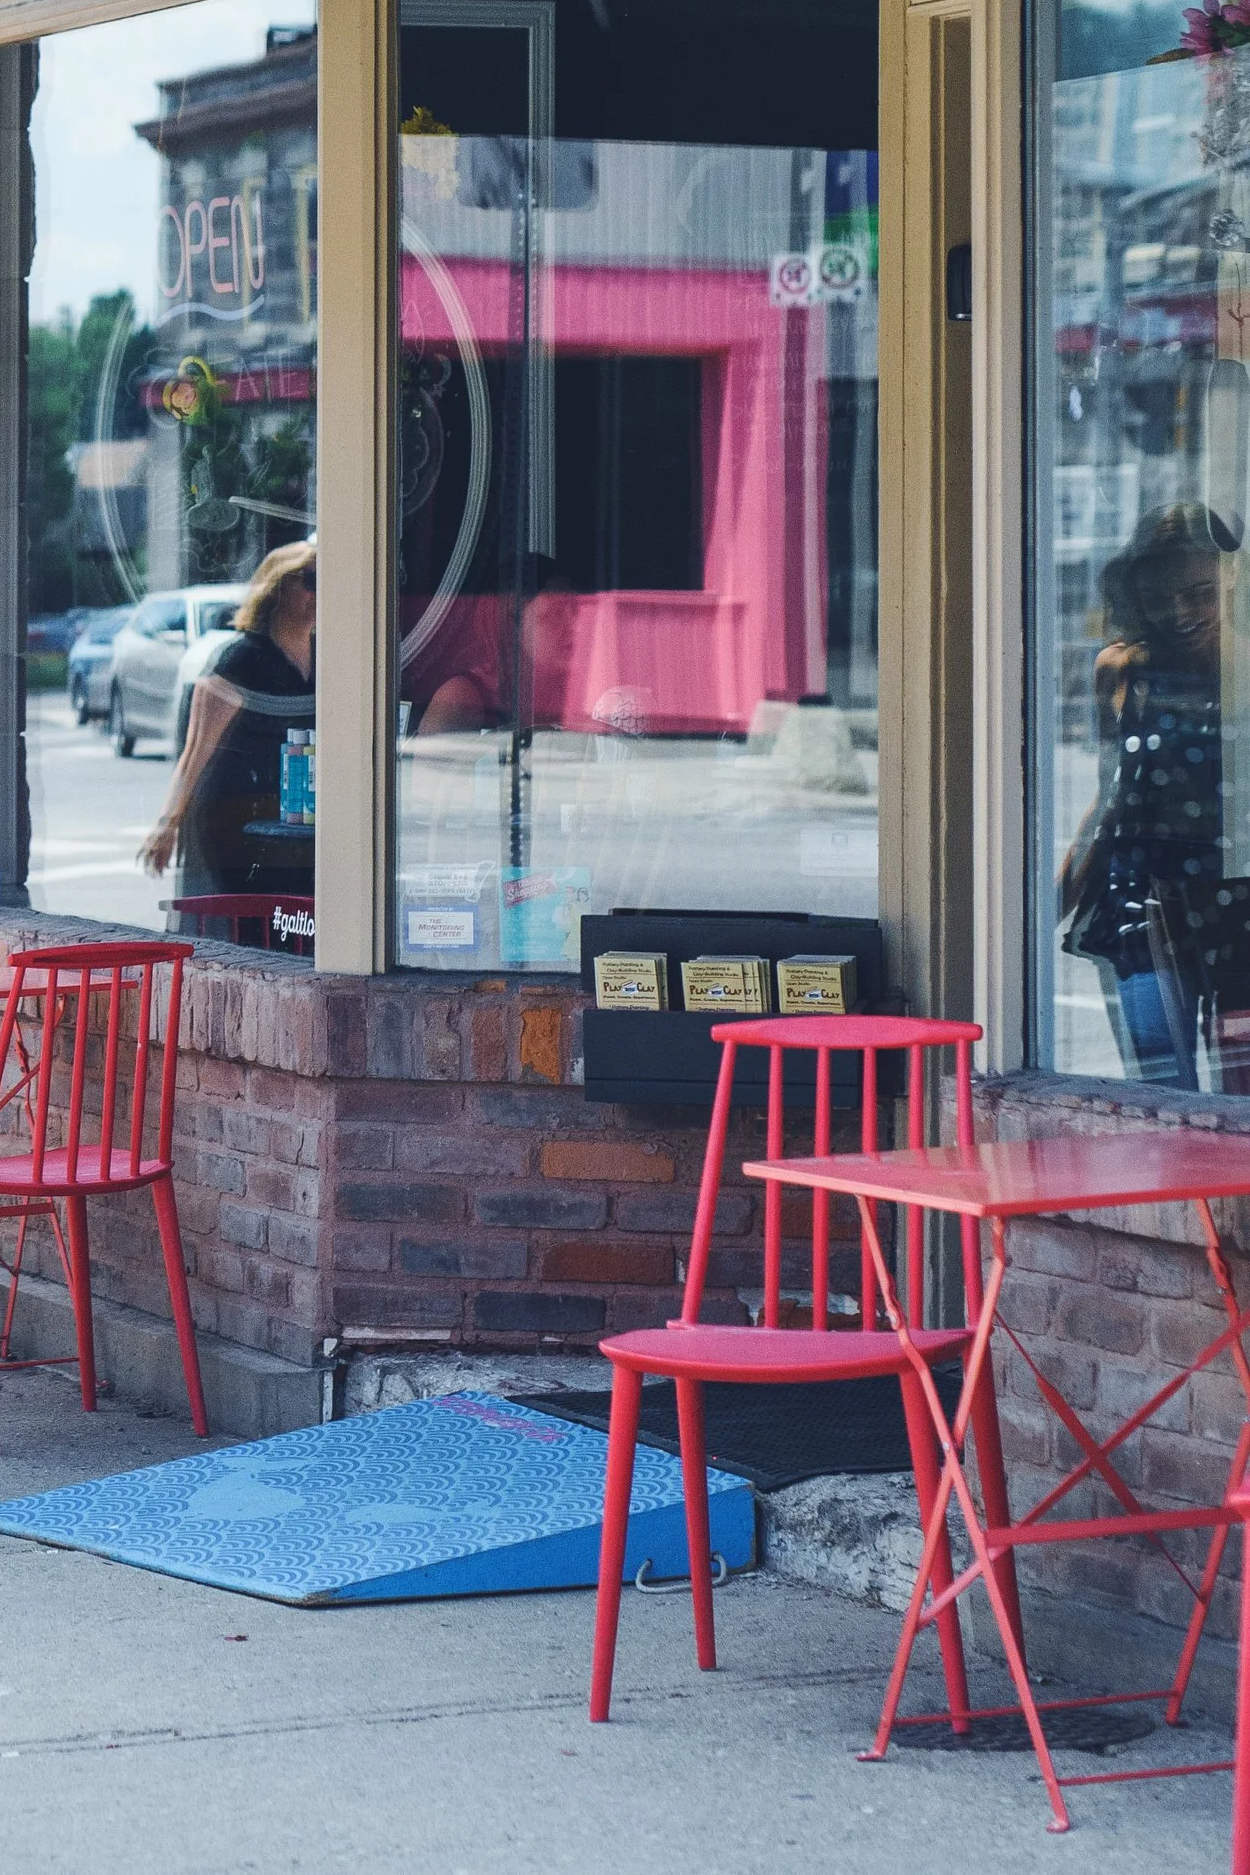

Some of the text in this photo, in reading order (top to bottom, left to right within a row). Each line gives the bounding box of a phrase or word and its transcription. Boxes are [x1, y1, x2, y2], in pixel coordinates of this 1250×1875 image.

[156, 191, 265, 298] OPEN
[603, 981, 622, 992] PLAY
[636, 982, 655, 993] CLAY
[689, 985, 708, 995] PLAY
[723, 985, 742, 995] CLAY
[786, 987, 806, 998] PLAY
[821, 989, 840, 999] CLAY
